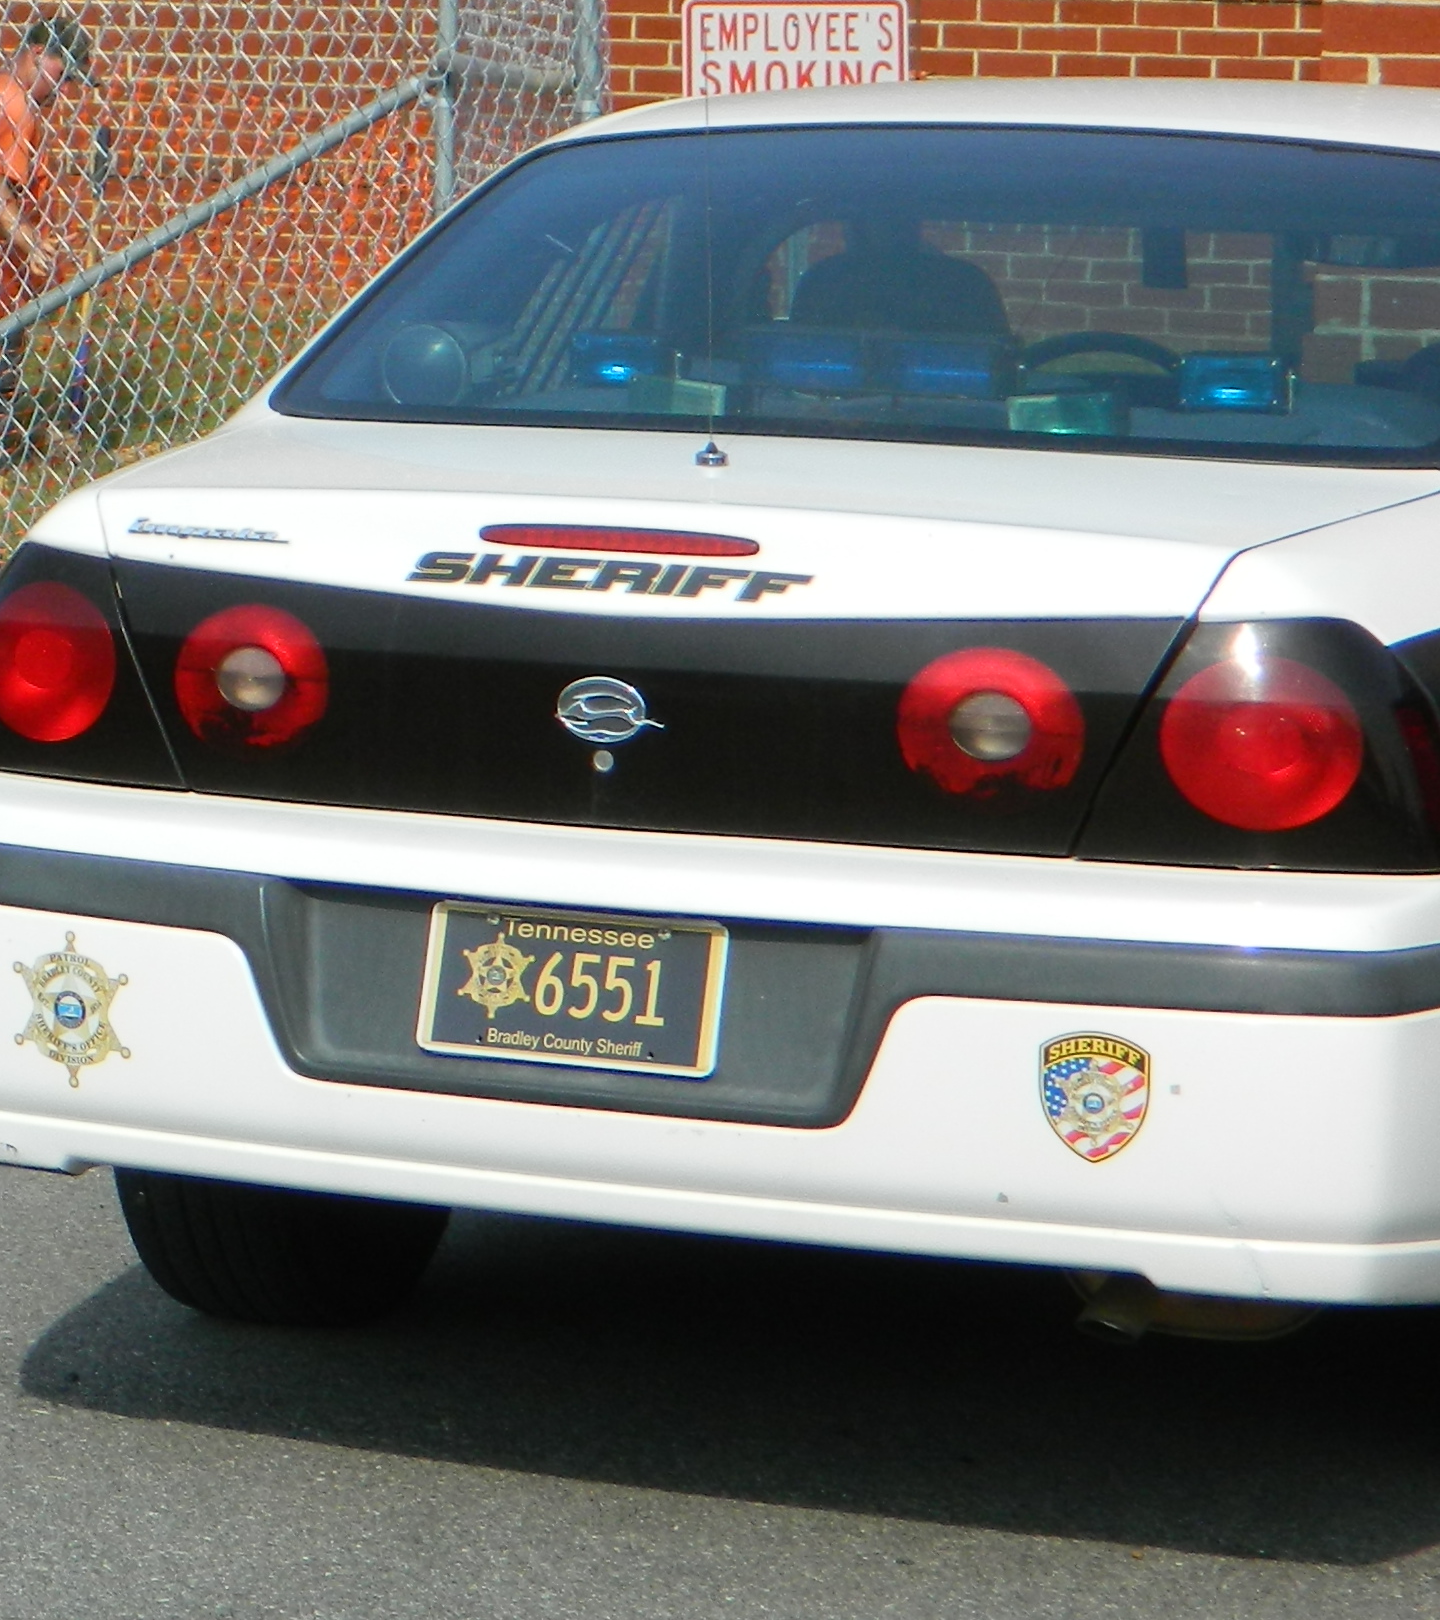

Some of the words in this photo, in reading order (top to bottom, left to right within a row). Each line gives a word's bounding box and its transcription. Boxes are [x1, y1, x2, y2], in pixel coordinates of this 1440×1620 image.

[699, 11, 894, 53] EMPLOYEE'S
[404, 550, 817, 603] SHERIFF
[504, 917, 656, 950] Tennessee
[48, 952, 91, 968] PATROL
[72, 966, 101, 993] COUNTY
[534, 951, 665, 1027] 6551
[79, 1021, 106, 1051] OFFICE
[486, 1027, 541, 1050] Bradley
[543, 1033, 594, 1056] County
[596, 1038, 643, 1058] Sheriff
[48, 1049, 95, 1065] DIVISION
[1048, 1038, 1142, 1067] SHERIFF
